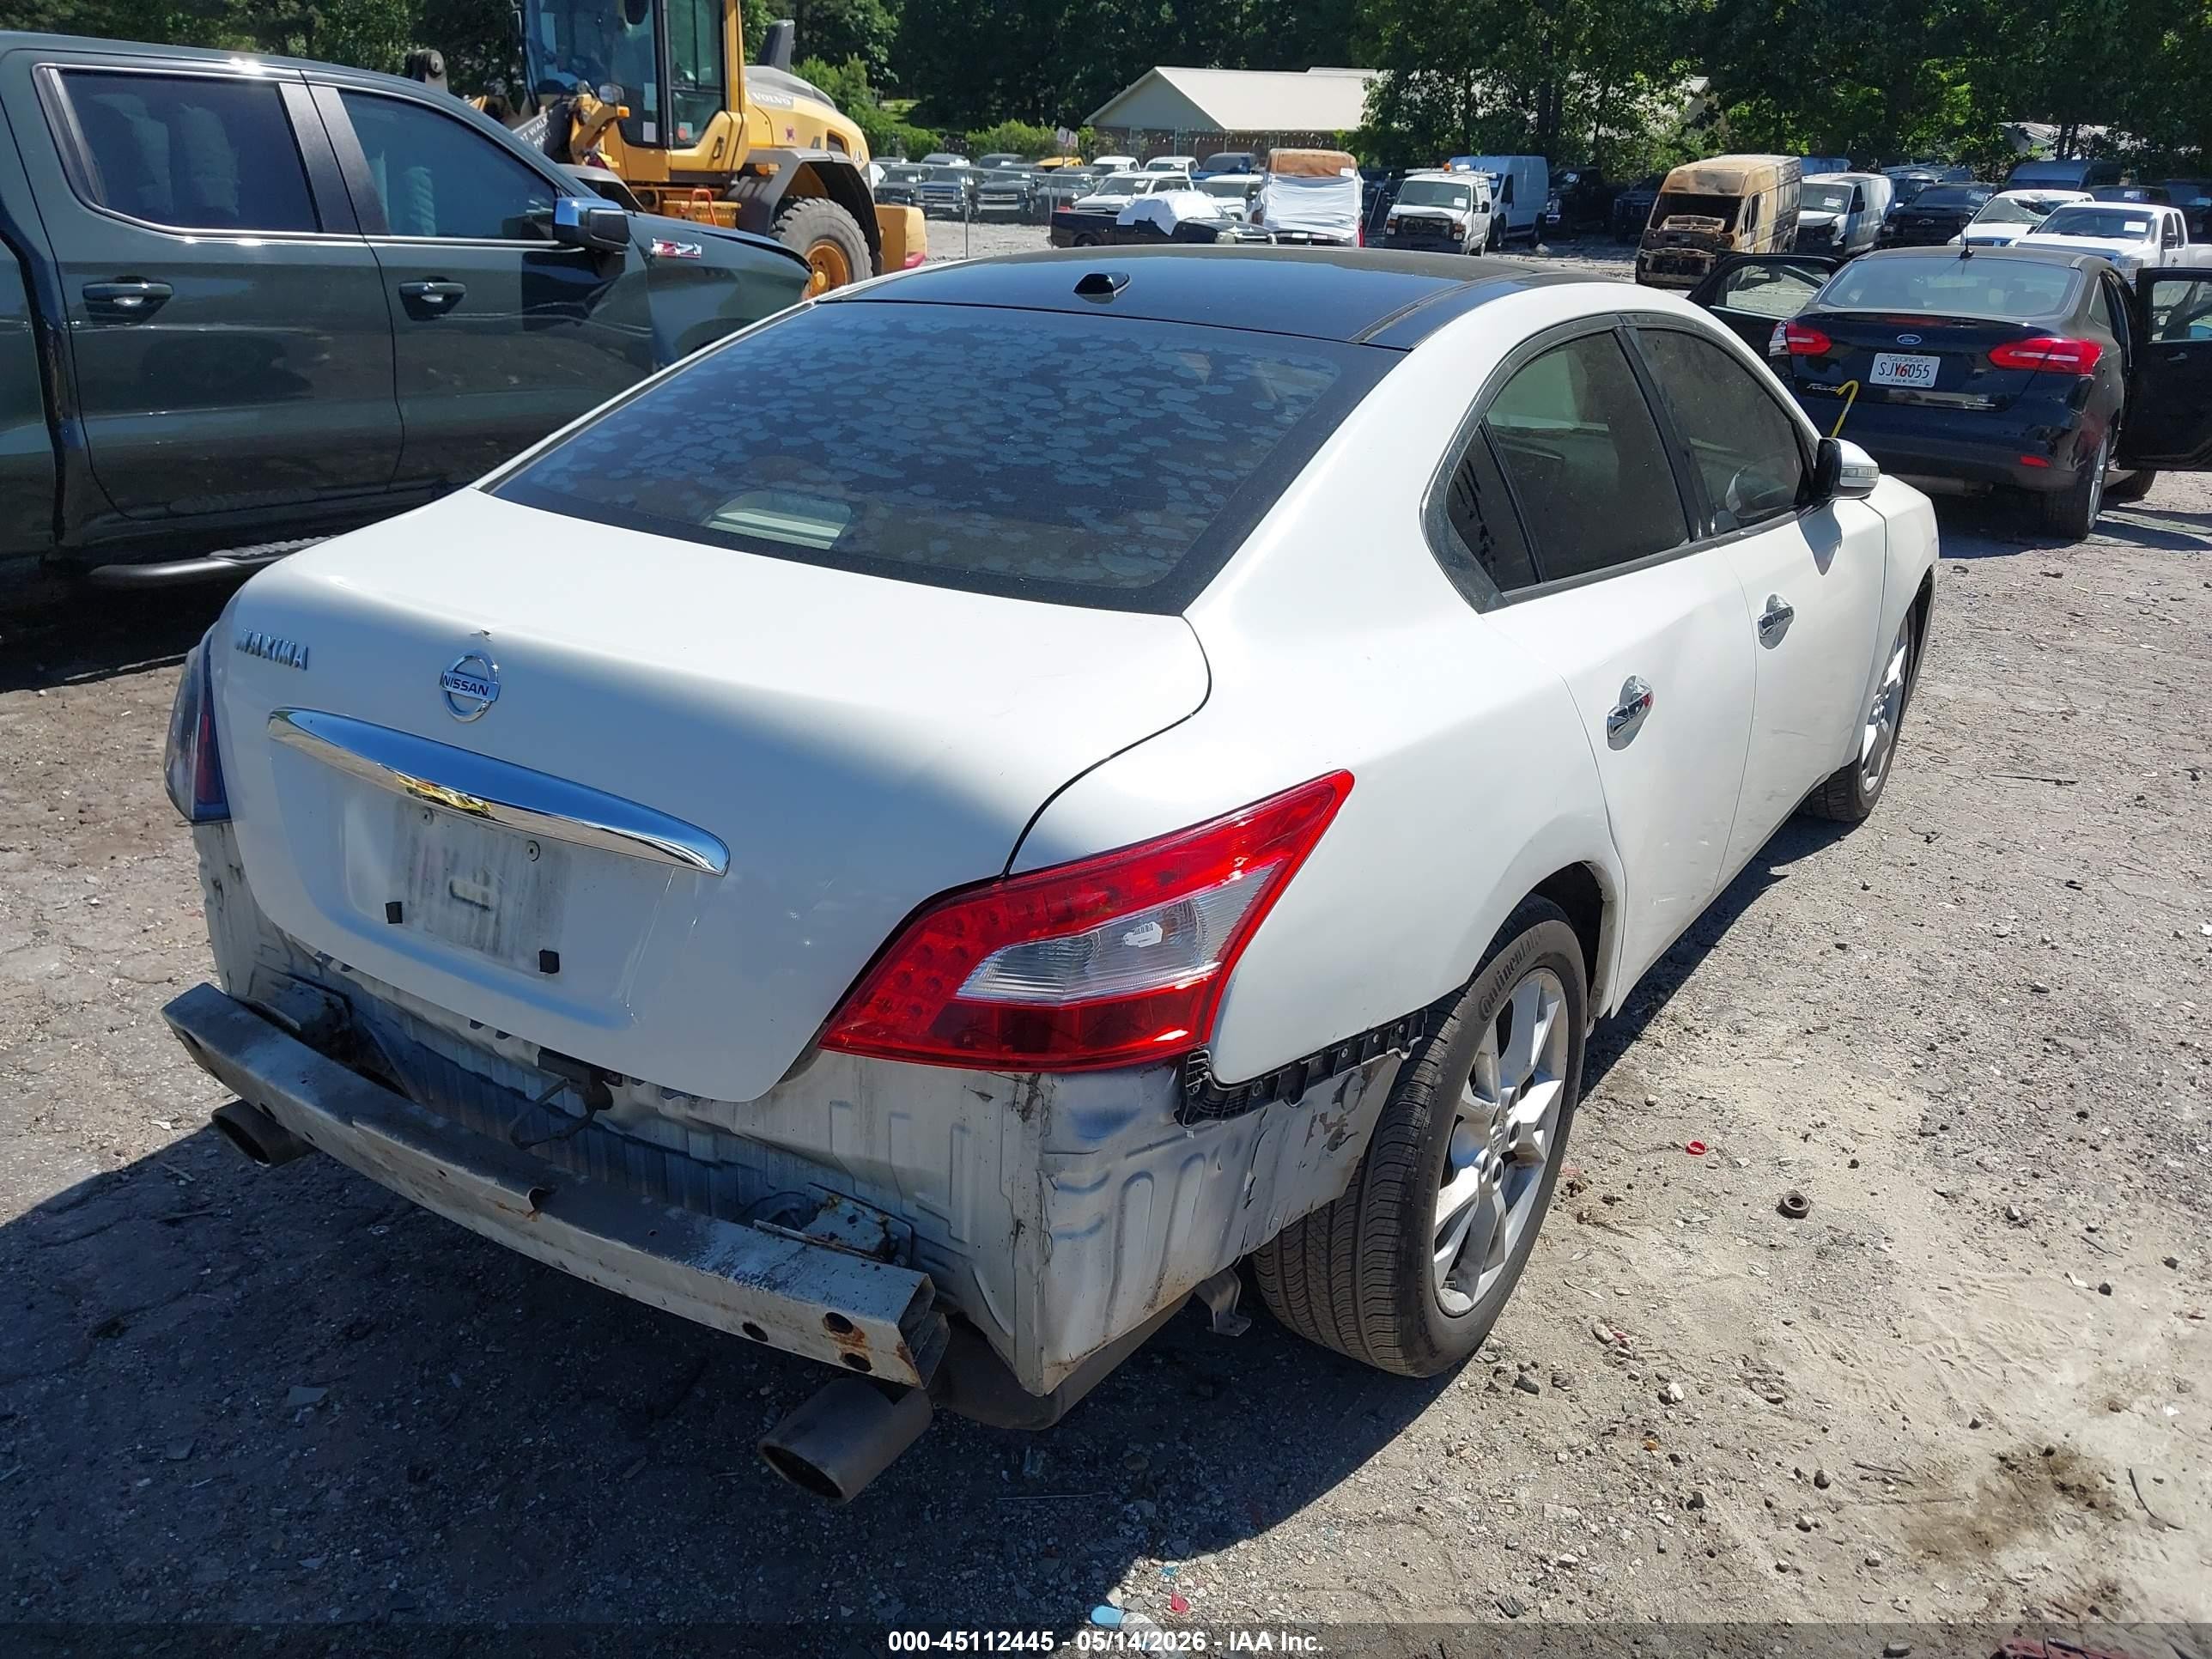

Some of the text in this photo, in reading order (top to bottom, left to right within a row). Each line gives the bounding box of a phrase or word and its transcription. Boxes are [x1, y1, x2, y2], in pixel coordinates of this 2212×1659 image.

[751, 92, 793, 106] VOLVO
[1878, 362, 1931, 379] SJY6055
[234, 628, 308, 671] MAXIMA
[443, 674, 489, 696] NISSAN
